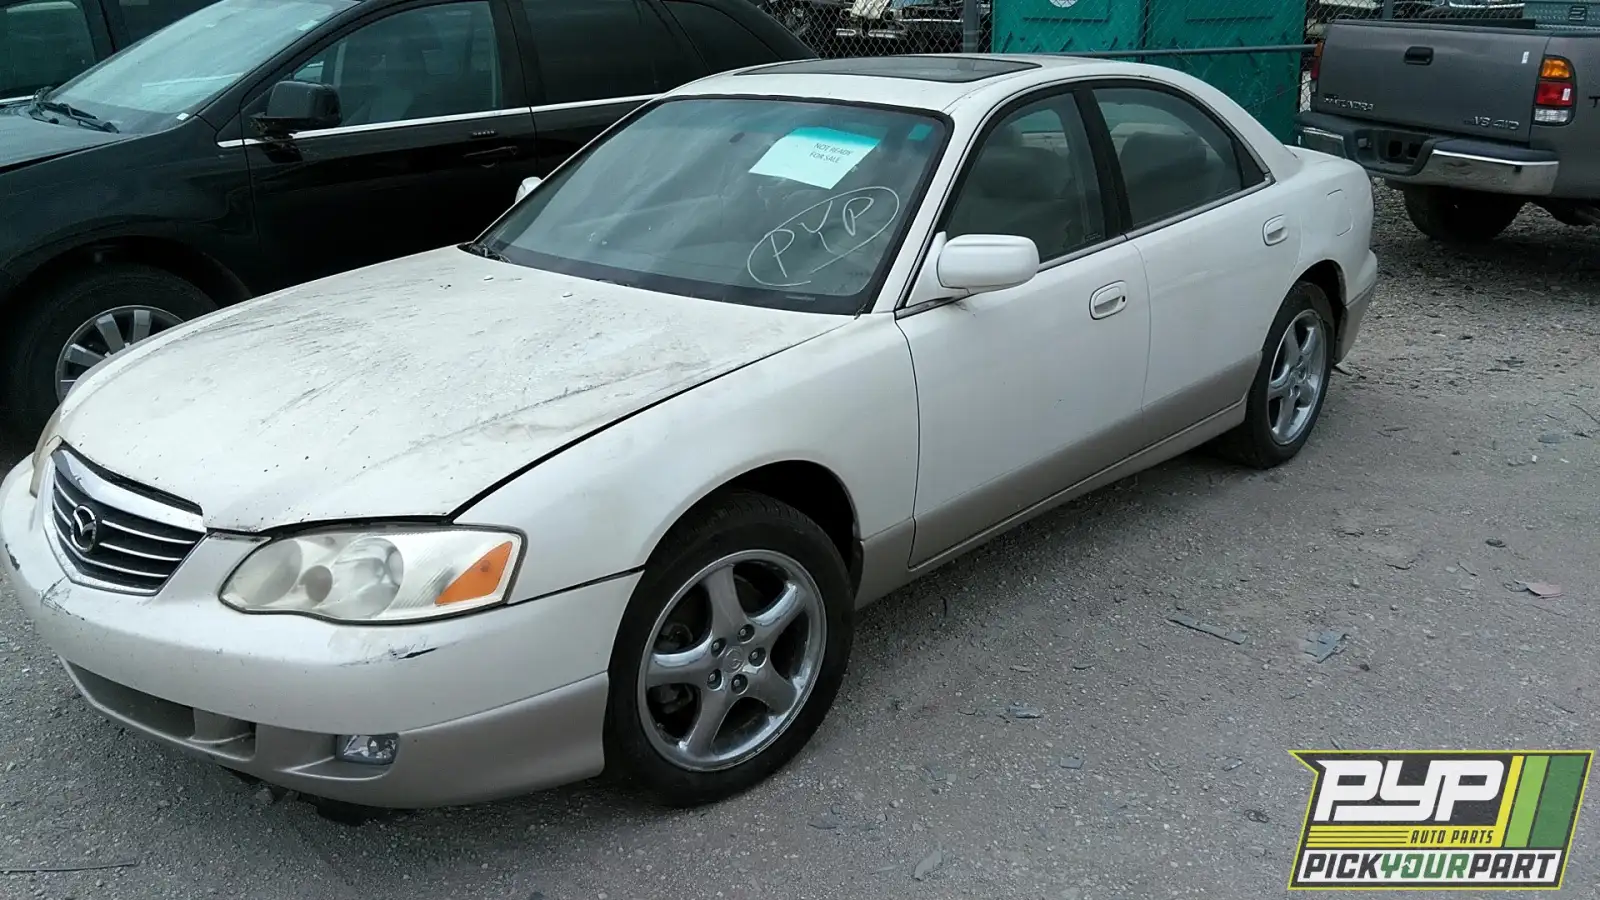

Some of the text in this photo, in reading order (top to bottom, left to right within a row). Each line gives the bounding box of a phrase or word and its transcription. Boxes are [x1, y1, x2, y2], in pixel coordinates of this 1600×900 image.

[813, 143, 853, 156] NOT READY
[809, 151, 841, 163] FOR SALE
[769, 197, 874, 278] PYP
